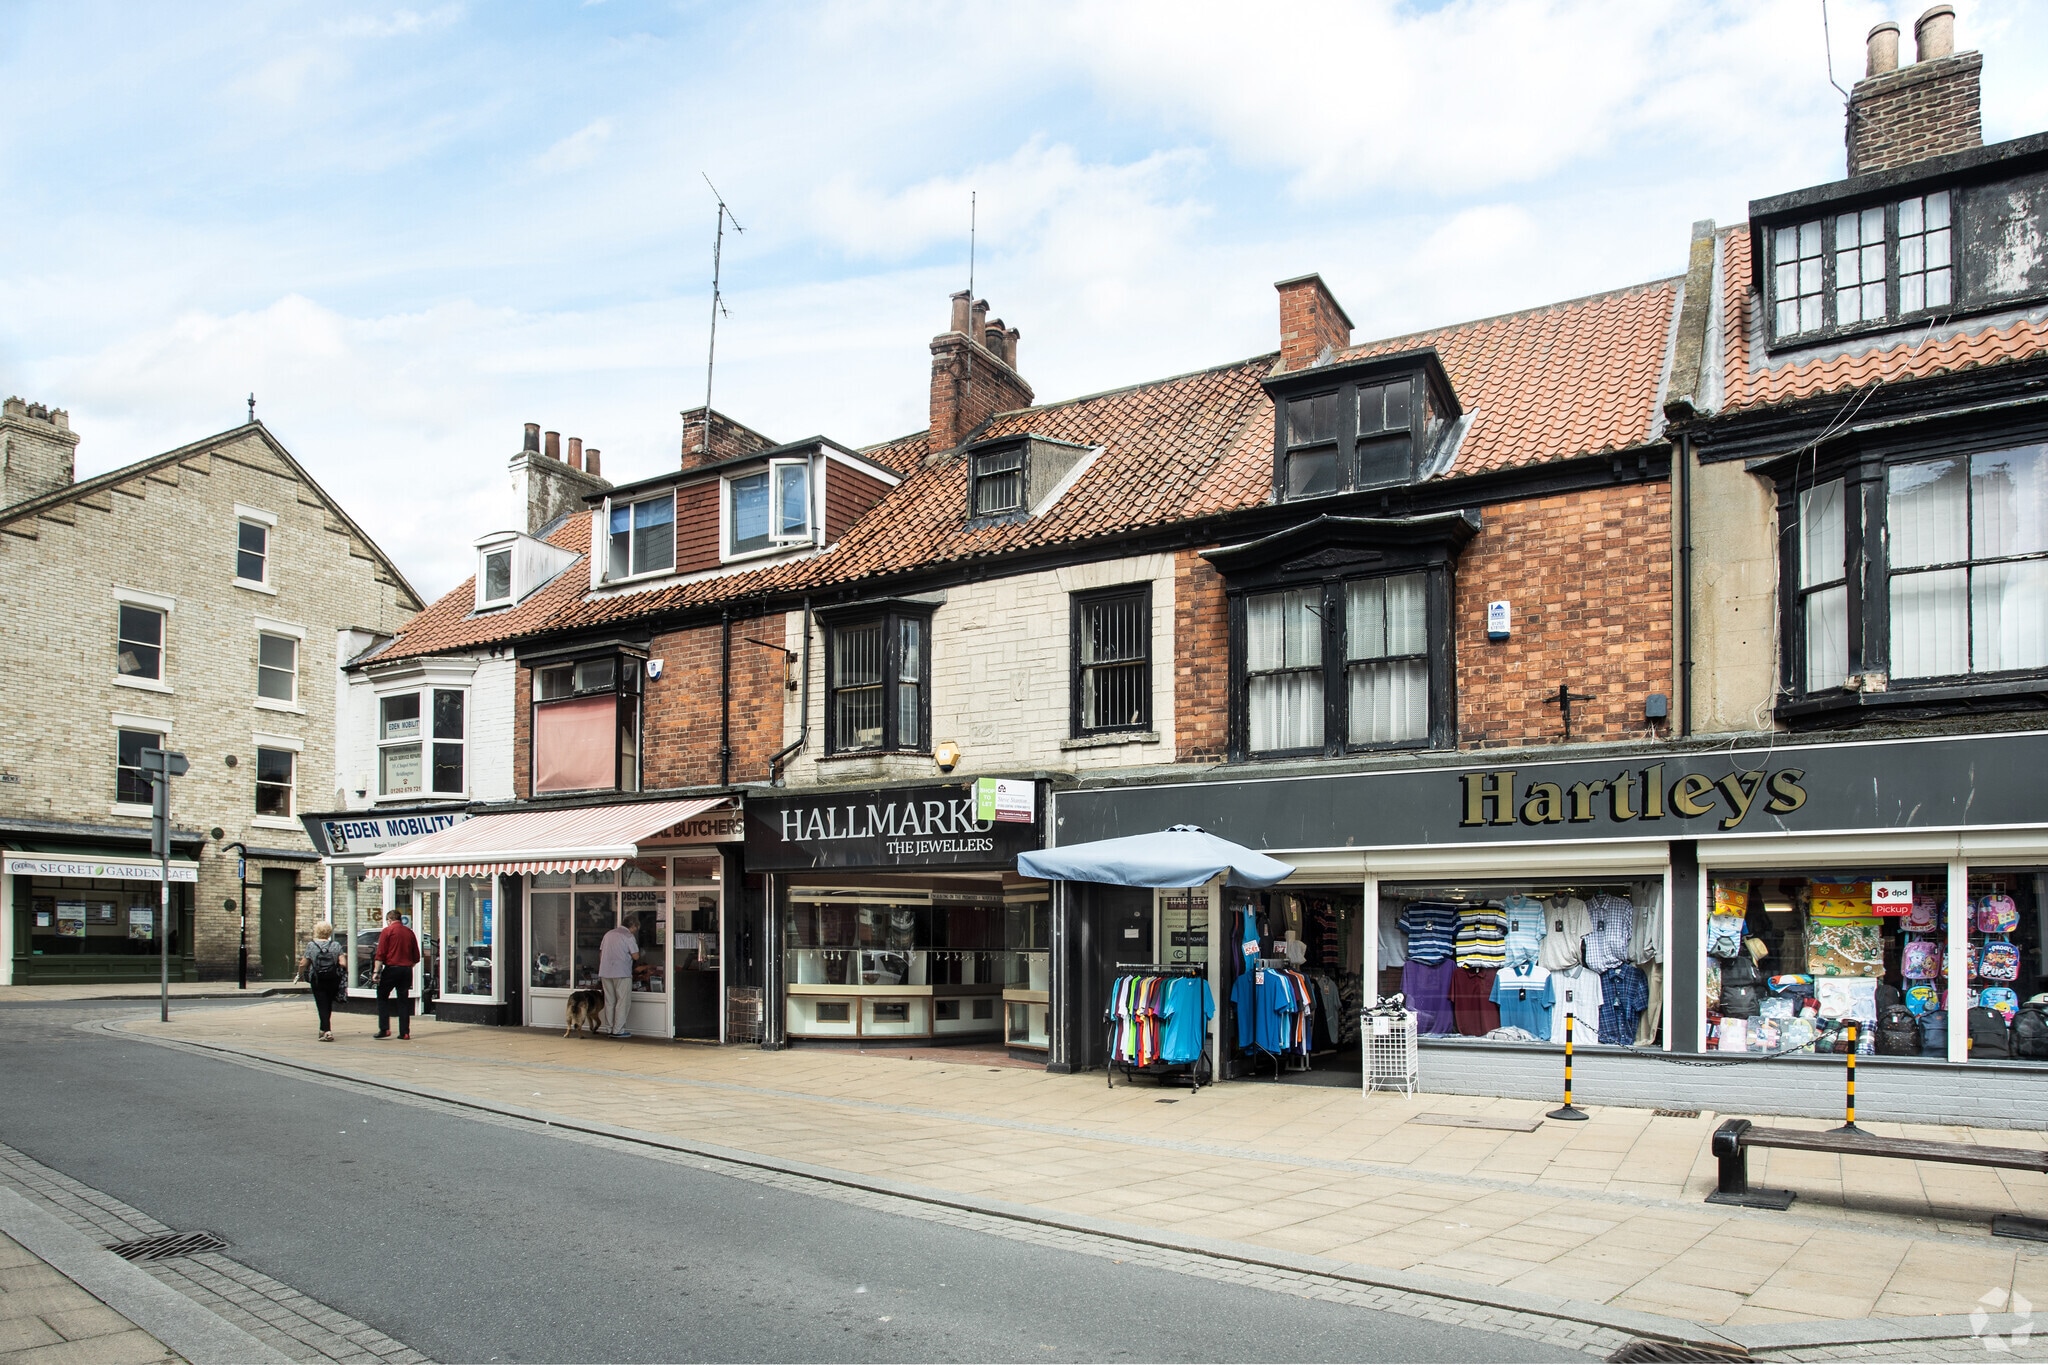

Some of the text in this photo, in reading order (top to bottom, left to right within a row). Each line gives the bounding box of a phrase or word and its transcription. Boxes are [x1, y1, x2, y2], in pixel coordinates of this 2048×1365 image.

[1459, 761, 1809, 832] Hartleys
[344, 815, 455, 839] EDEN MOBILITY
[674, 818, 744, 837] BUTCHERS
[886, 838, 994, 857] THE JEWELLERS
[40, 863, 94, 875] SECRET
[106, 866, 160, 878] GARDEN
[167, 870, 193, 880] CAFE
[1891, 889, 1908, 898] dpd
[1876, 905, 1909, 914] Pickup
[1984, 965, 2014, 979] PUPS
